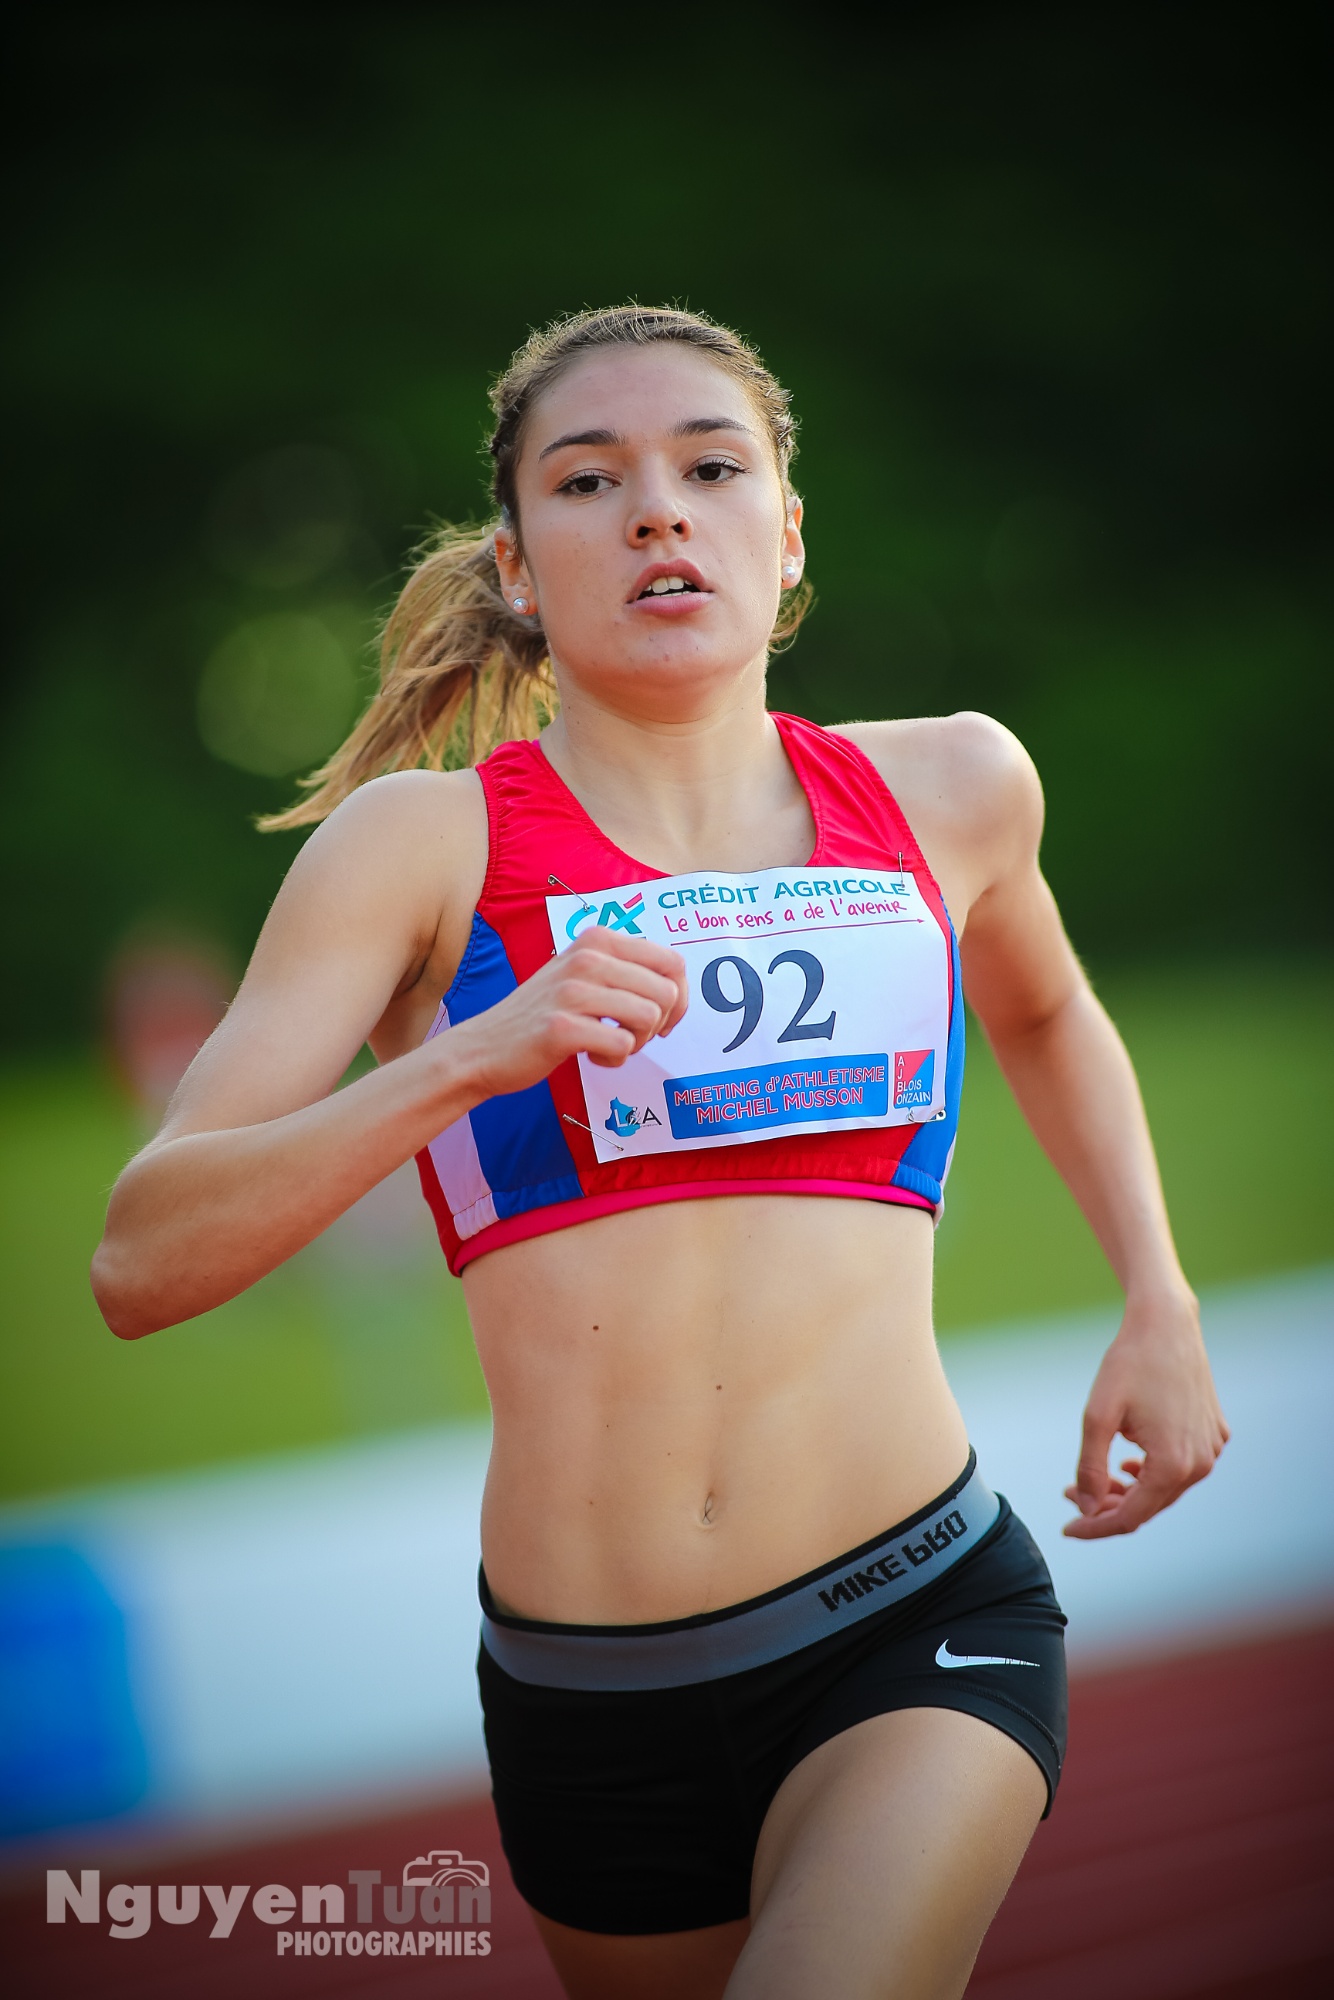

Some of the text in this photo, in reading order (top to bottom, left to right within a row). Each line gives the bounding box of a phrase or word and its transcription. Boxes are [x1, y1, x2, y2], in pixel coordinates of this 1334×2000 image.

[657, 879, 911, 910] CRÉDIT AGRICOLE
[663, 914, 690, 933] Le
[694, 909, 730, 929] bon
[735, 910, 775, 929] sens
[783, 908, 796, 922] a
[803, 901, 826, 920] de
[700, 949, 837, 1054] 92
[673, 1065, 886, 1107] MEETING d'ATHLETISME
[896, 1079, 923, 1093] BLOIS
[896, 1090, 931, 1105] ONZAIN
[695, 1086, 864, 1125] MICHEL MUSSON
